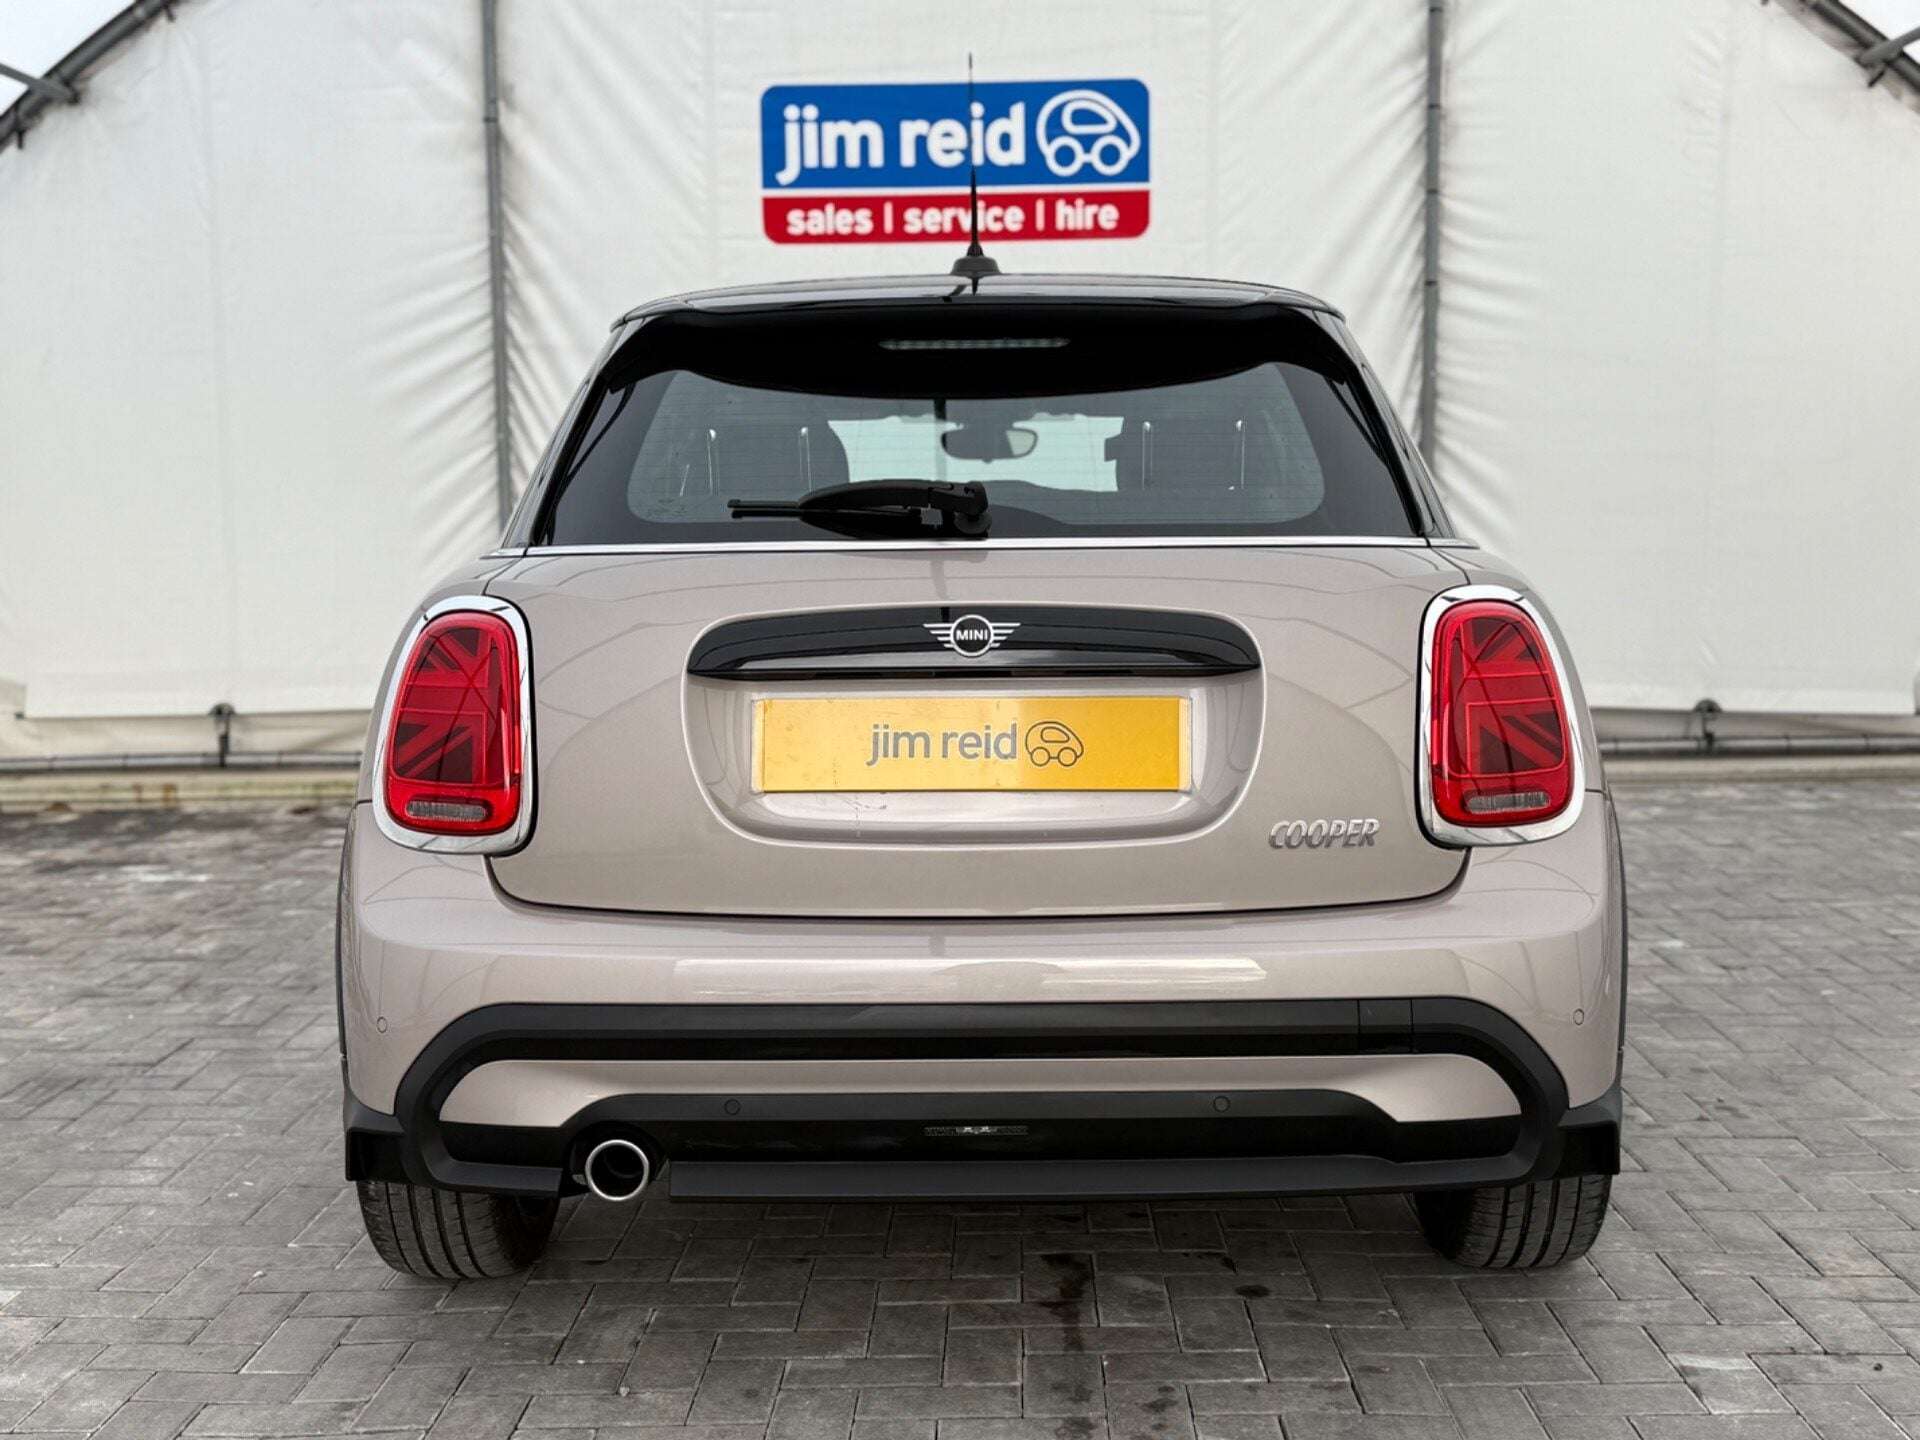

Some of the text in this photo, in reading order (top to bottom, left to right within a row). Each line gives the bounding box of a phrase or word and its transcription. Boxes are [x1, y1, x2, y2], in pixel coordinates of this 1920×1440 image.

[775, 101, 1026, 186] jim reid
[786, 198, 1120, 236] sales service hire
[956, 629, 988, 641] MINI
[865, 722, 1018, 767] jim reid
[1268, 818, 1380, 849] COOPER
